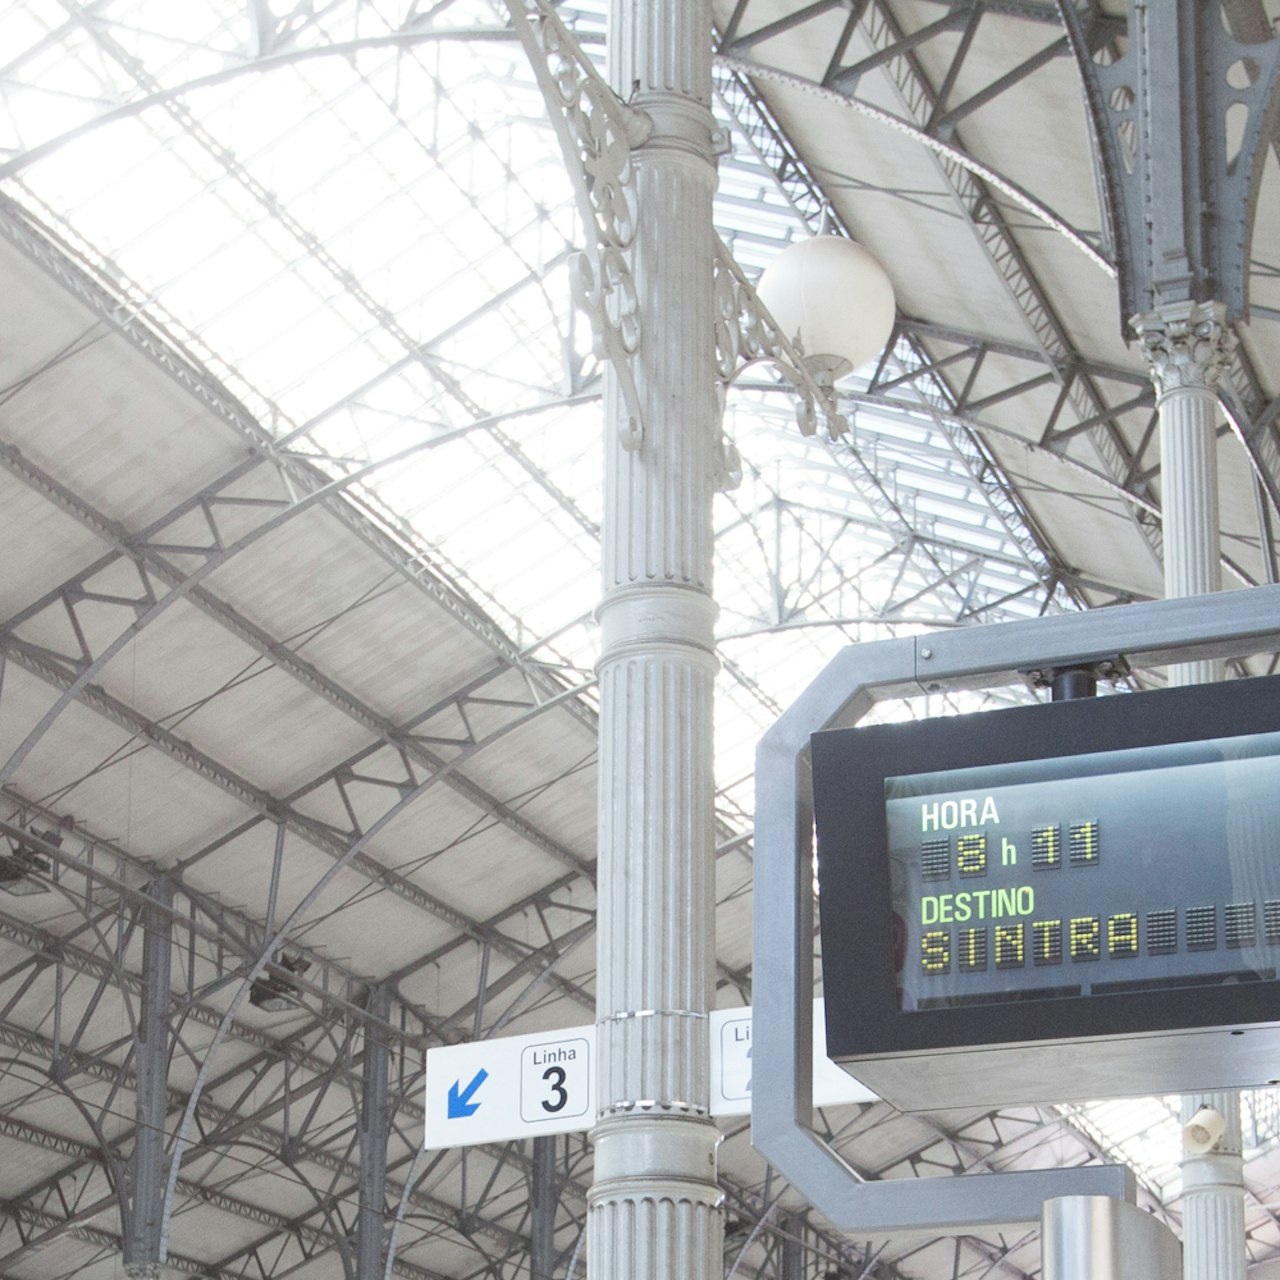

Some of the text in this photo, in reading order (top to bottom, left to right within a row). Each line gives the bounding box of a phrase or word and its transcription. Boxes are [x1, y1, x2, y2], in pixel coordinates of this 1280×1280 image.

[921, 796, 1000, 832] HORA
[957, 834, 986, 873] 8
[1001, 838, 1017, 865] h
[921, 886, 1034, 925] DESTINO
[921, 913, 1138, 970] SINTRA
[533, 1046, 577, 1065] Linha
[541, 1066, 569, 1113] 3
